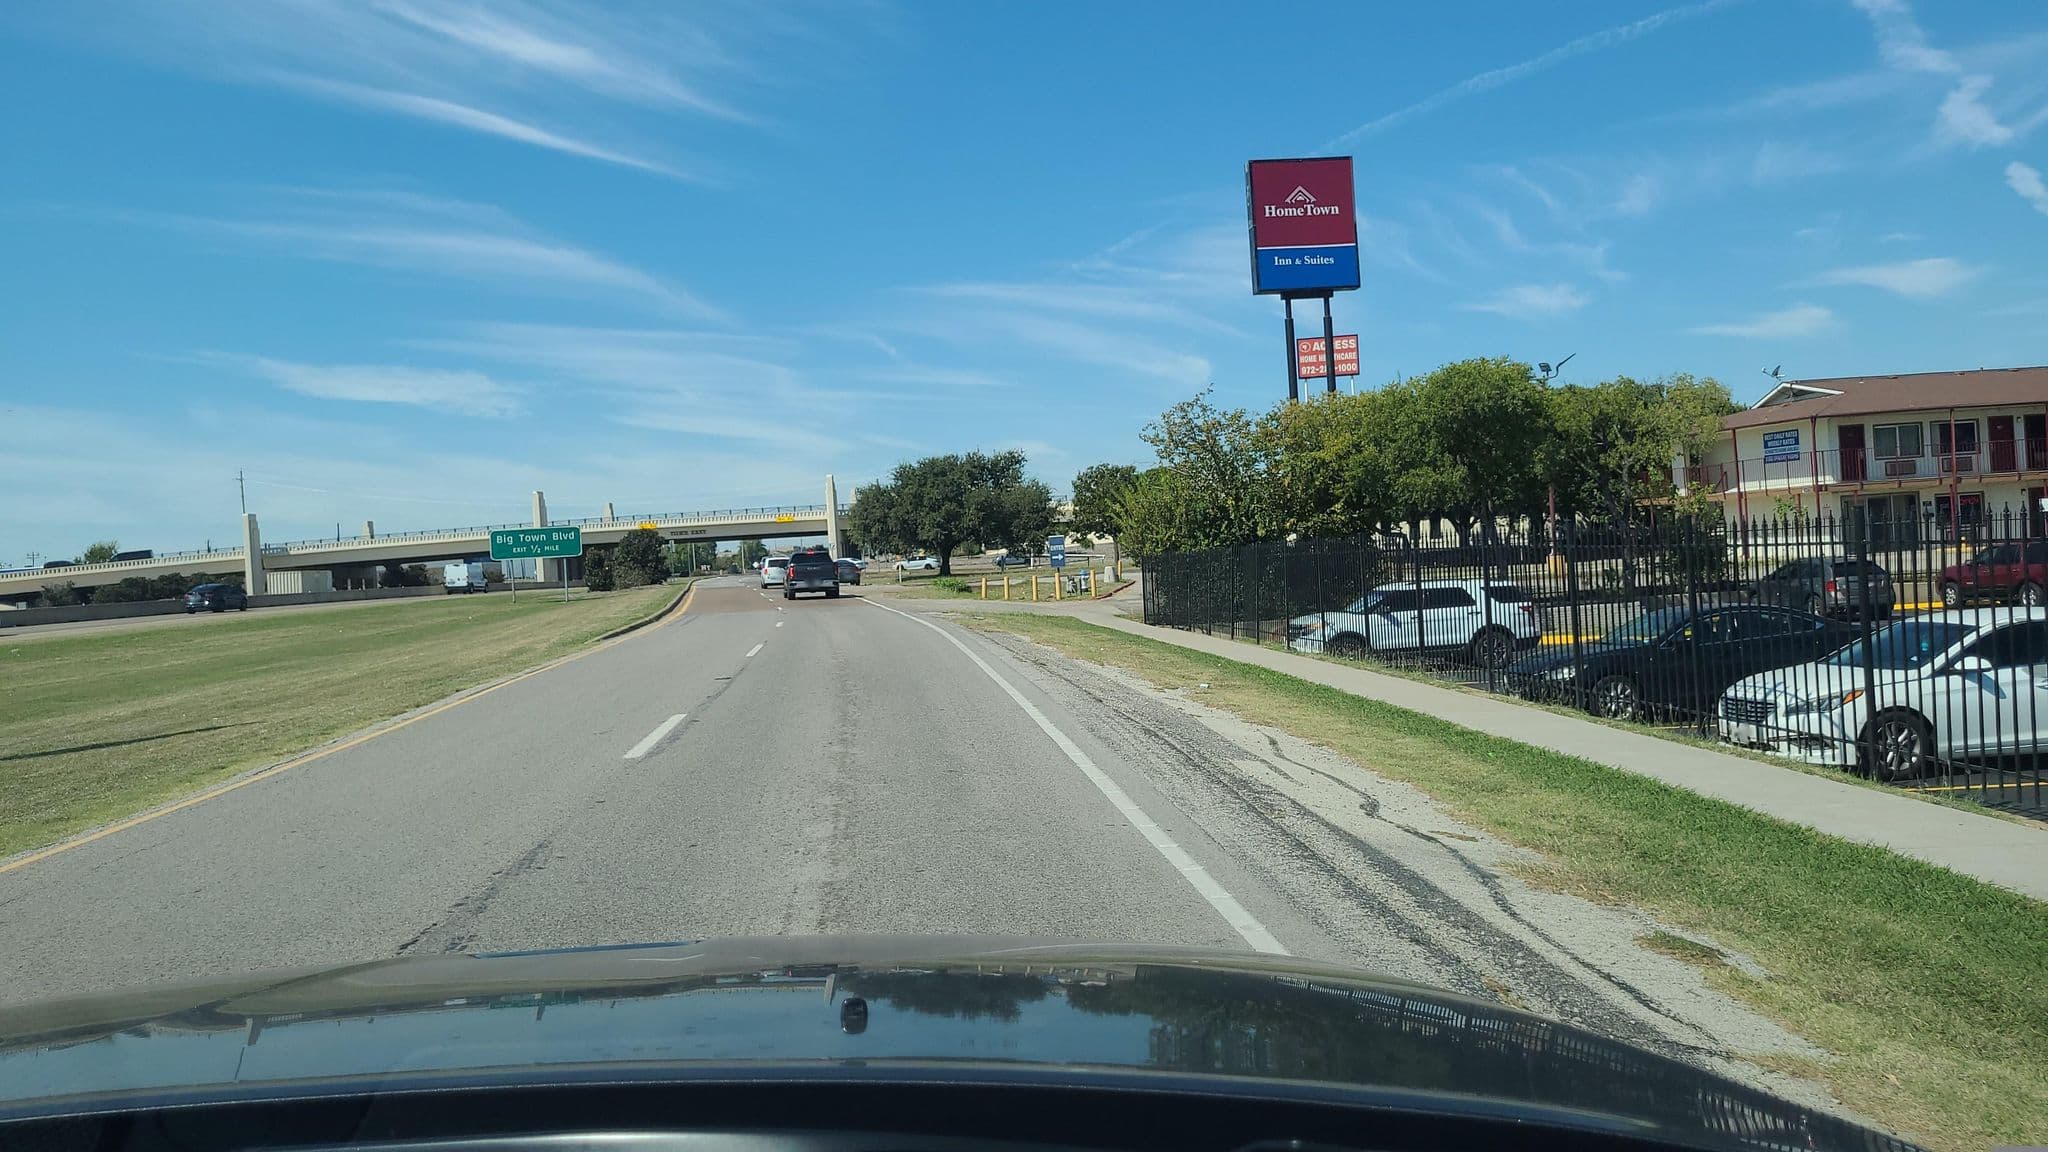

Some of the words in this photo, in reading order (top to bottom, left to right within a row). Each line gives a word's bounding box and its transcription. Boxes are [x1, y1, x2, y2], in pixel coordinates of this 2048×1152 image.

[1274, 256, 1292, 266] Inn
[1295, 257, 1302, 265] &
[1303, 254, 1335, 265] Suites
[1312, 339, 1356, 352] ACESS
[1299, 354, 1317, 363] HOME
[1302, 363, 1357, 375] 972-2-1000
[496, 534, 513, 545] Big
[519, 533, 546, 542] Town
[552, 531, 575, 541] Blvd
[544, 544, 560, 552] MILE
